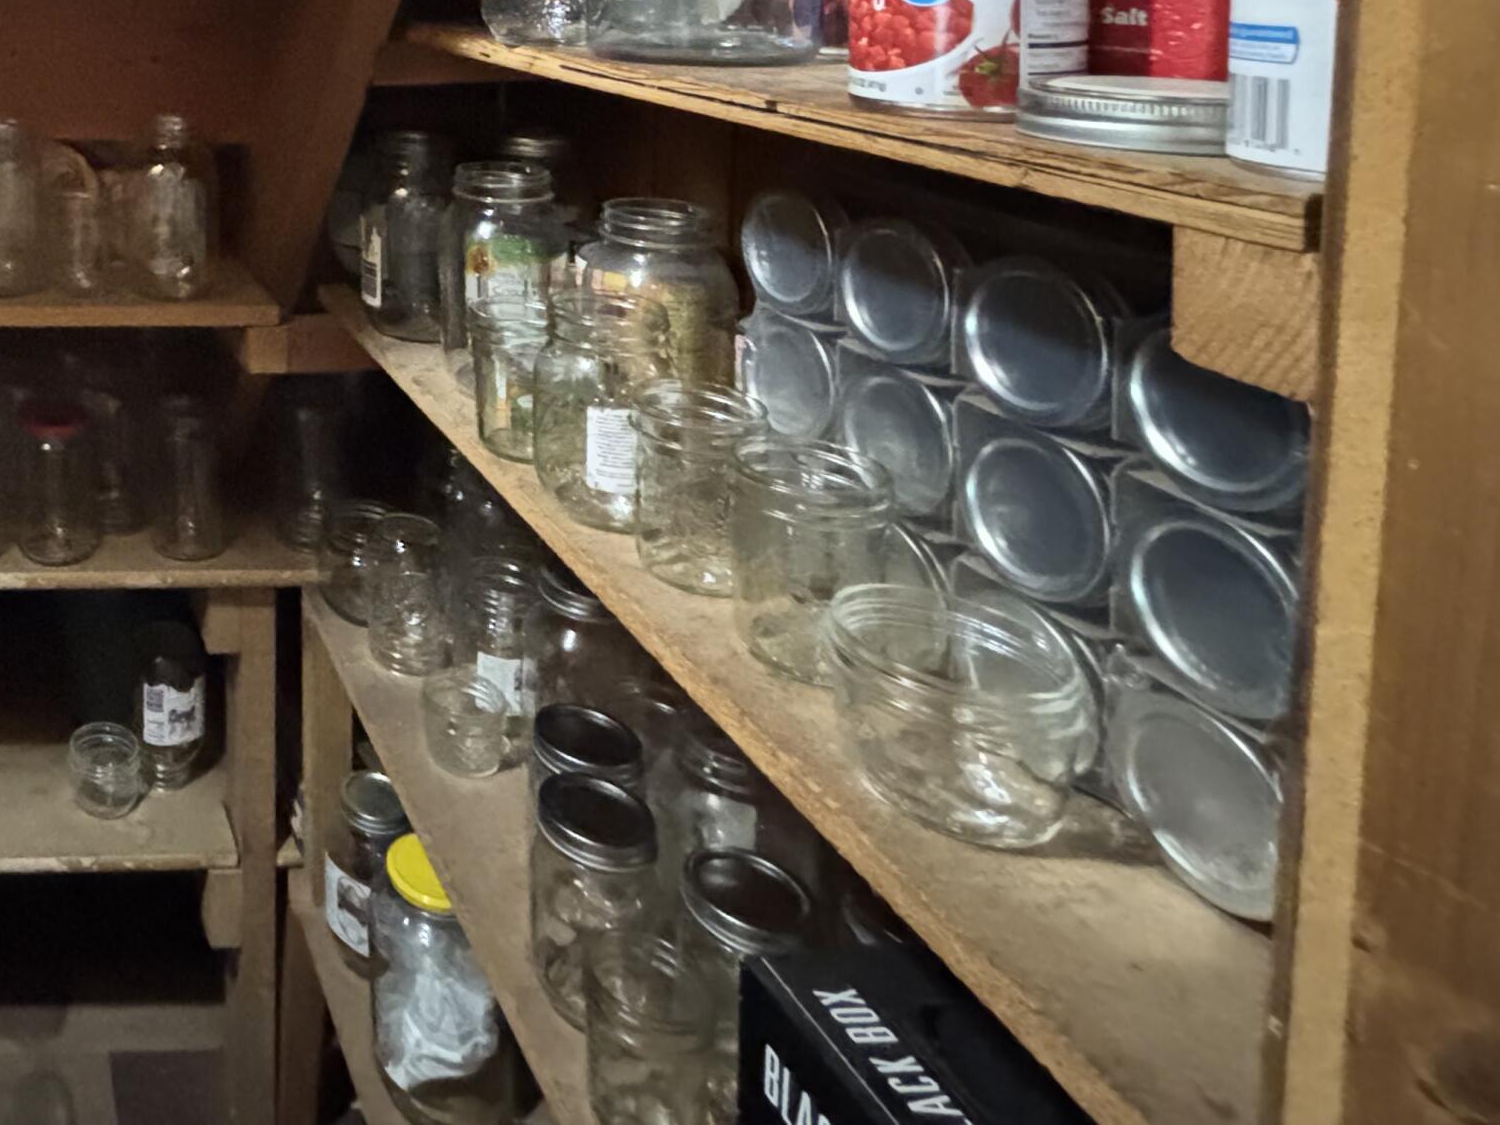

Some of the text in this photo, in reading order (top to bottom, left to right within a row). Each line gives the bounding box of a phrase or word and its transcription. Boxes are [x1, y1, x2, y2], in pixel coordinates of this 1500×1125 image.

[1100, 6, 1149, 27] Salt
[764, 1043, 832, 1125] BLA
[812, 988, 973, 1125] ACK BOX
